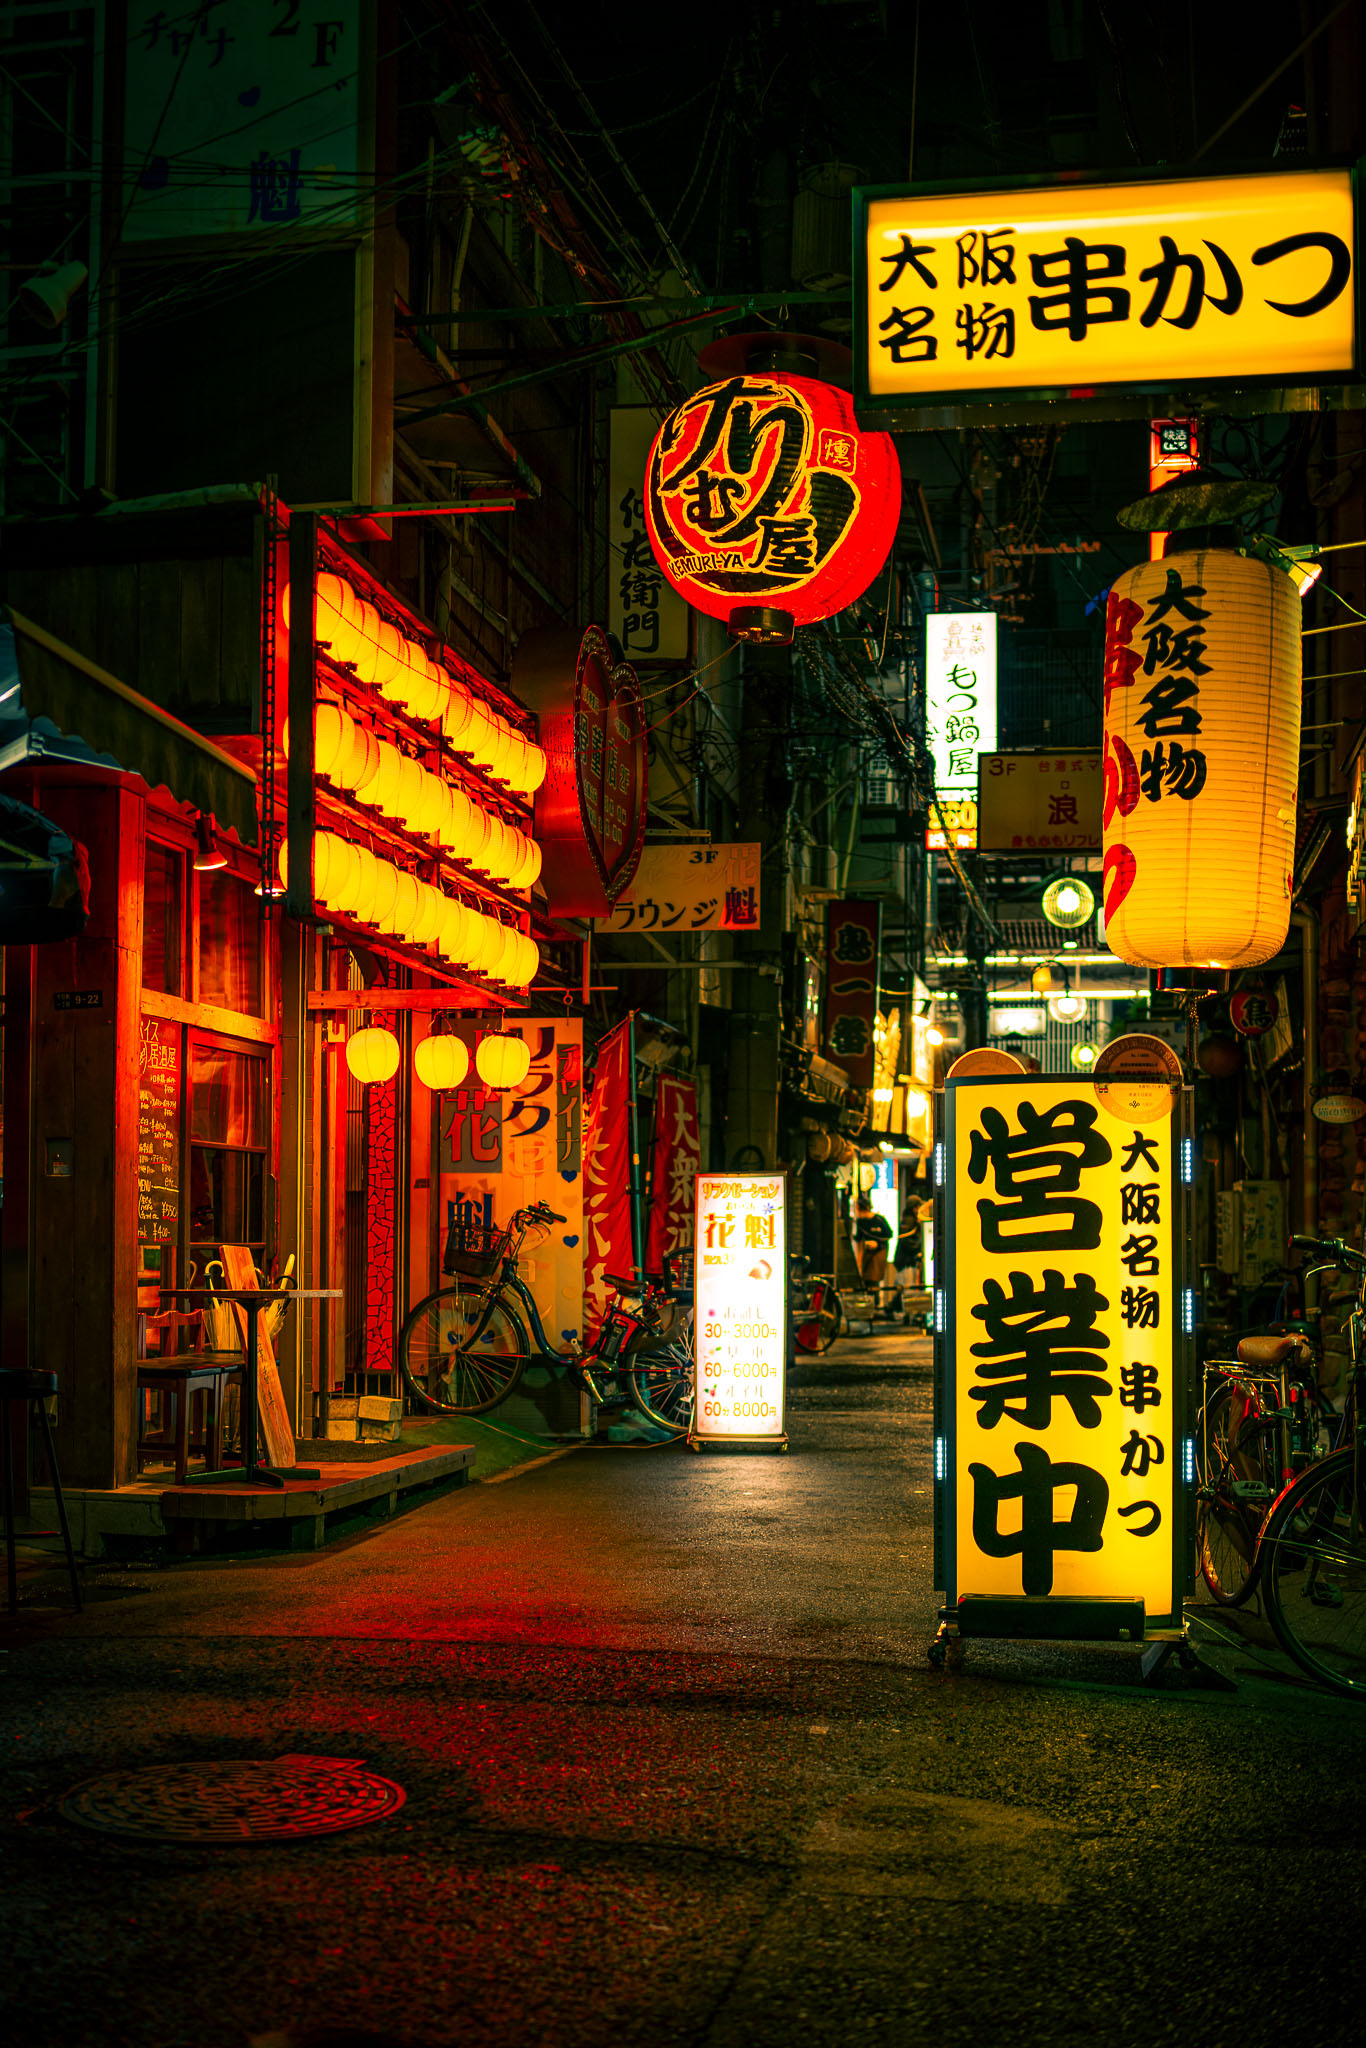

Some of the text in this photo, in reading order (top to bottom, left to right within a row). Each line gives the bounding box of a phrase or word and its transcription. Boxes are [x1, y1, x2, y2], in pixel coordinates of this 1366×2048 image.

[269, 0, 343, 67] 2F
[878, 227, 1017, 293] 大阪
[1027, 231, 1352, 342] 串かつ
[878, 302, 1016, 364] 名物
[668, 553, 744, 580] KEMURI-YA
[1132, 568, 1214, 803] 大阪名物
[946, 664, 980, 777] もつ鍋屋
[989, 758, 1017, 776] 3F
[688, 850, 719, 864] 3F
[614, 897, 719, 930] ラウンジ
[702, 1182, 779, 1201] リラクゼーション
[703, 1212, 777, 1250] 花魁
[1120, 1130, 1162, 1329] 大阪名物
[967, 1100, 1113, 1597] 営業中
[1117, 1362, 1165, 1538] 串かつ
